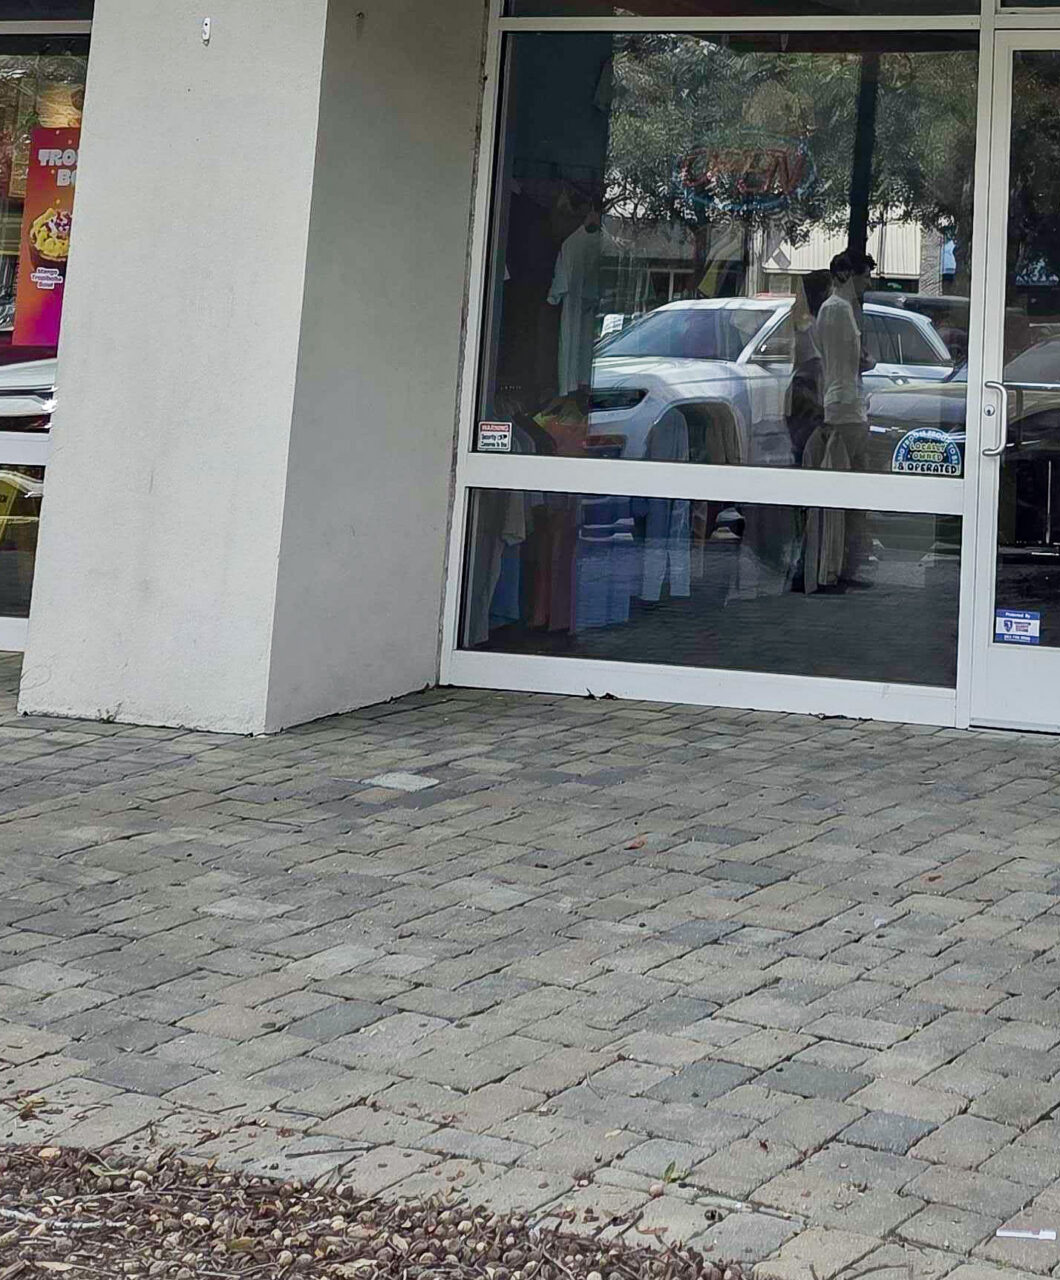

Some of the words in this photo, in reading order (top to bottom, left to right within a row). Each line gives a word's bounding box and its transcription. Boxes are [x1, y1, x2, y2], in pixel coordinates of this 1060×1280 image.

[38, 148, 78, 166] TRO
[909, 442, 946, 452] LOCALLY
[912, 451, 943, 462] OWNED
[897, 462, 904, 471] &
[907, 463, 957, 474] OPERATED
